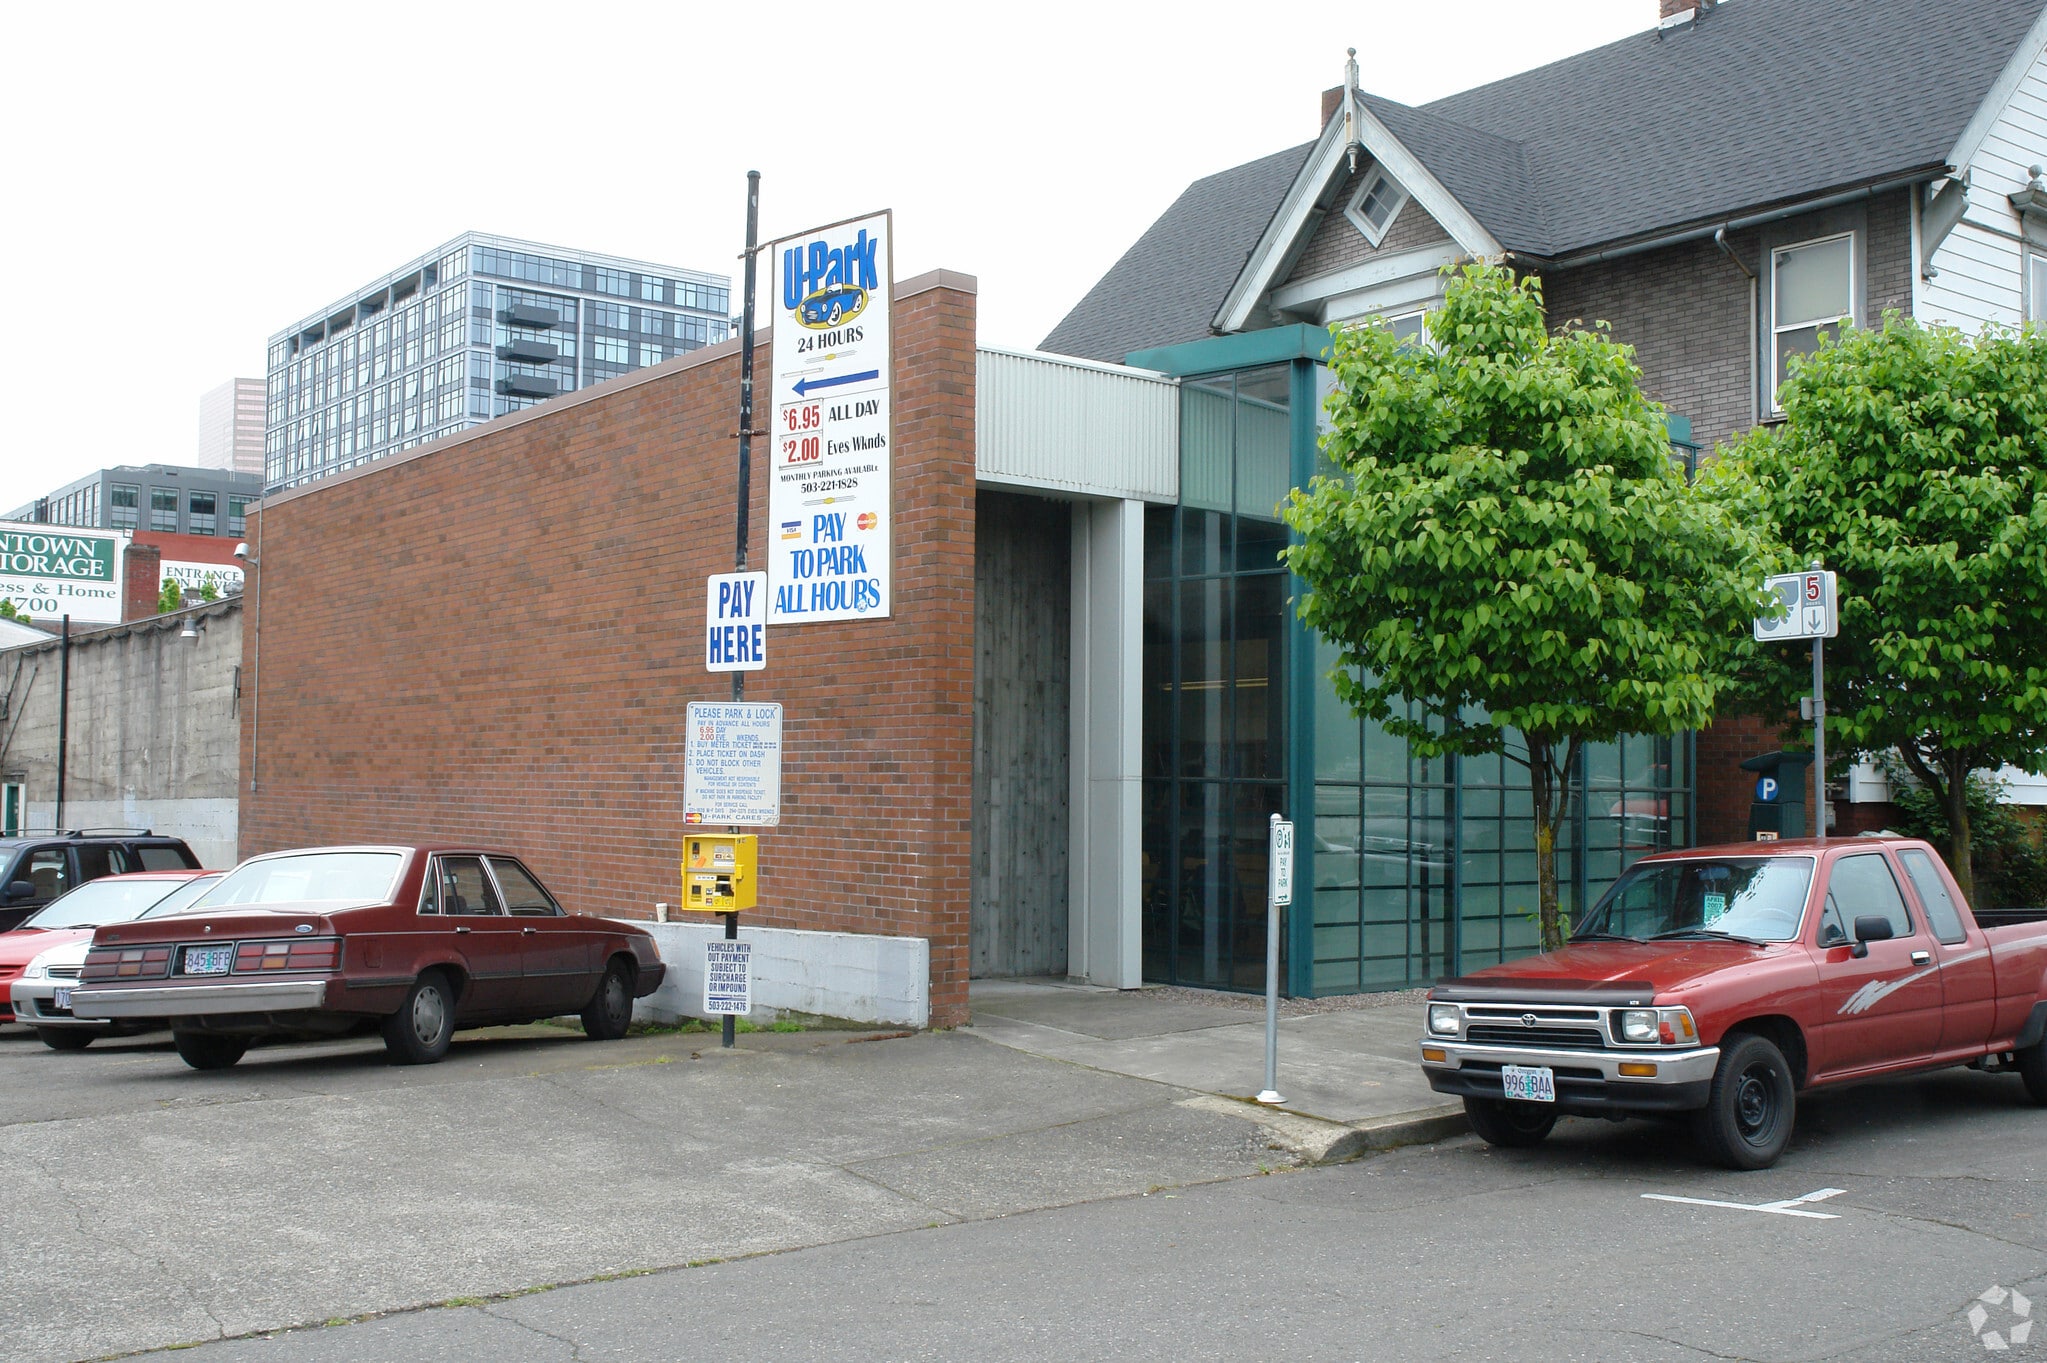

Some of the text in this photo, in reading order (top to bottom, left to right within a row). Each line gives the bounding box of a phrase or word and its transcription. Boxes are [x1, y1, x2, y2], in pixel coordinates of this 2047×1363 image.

[784, 229, 878, 310] U-Park
[797, 326, 864, 353] 24 HOURS
[783, 399, 880, 431] $6.95 ALL DAY
[783, 433, 886, 463] $2.00 Eves Wknds
[780, 471, 811, 482] MONTHLY
[813, 468, 843, 479] PARKING
[813, 512, 847, 543] PAY
[790, 544, 867, 579] TO PARK
[33, 583, 49, 594] &
[57, 584, 116, 598] Home
[775, 578, 880, 614] ALL HOURS
[1807, 575, 1820, 600] 5
[719, 580, 755, 618] PAY
[710, 624, 762, 663] HERE
[694, 707, 775, 719] PLEASE PARK & LOCK
[733, 741, 751, 749] TICKET
[739, 750, 747, 758] ON
[721, 759, 740, 767] BLOCK
[1763, 778, 1776, 800] P
[707, 943, 751, 952] VEHICLES WITH
[188, 952, 206, 967] 845
[708, 953, 749, 963] OUT PAYMENT
[711, 963, 746, 973] SUBJECT TO
[710, 973, 747, 982] SURCHARGE
[709, 983, 746, 992] OR IMPOUND
[1505, 1075, 1552, 1095] 996 BAA
